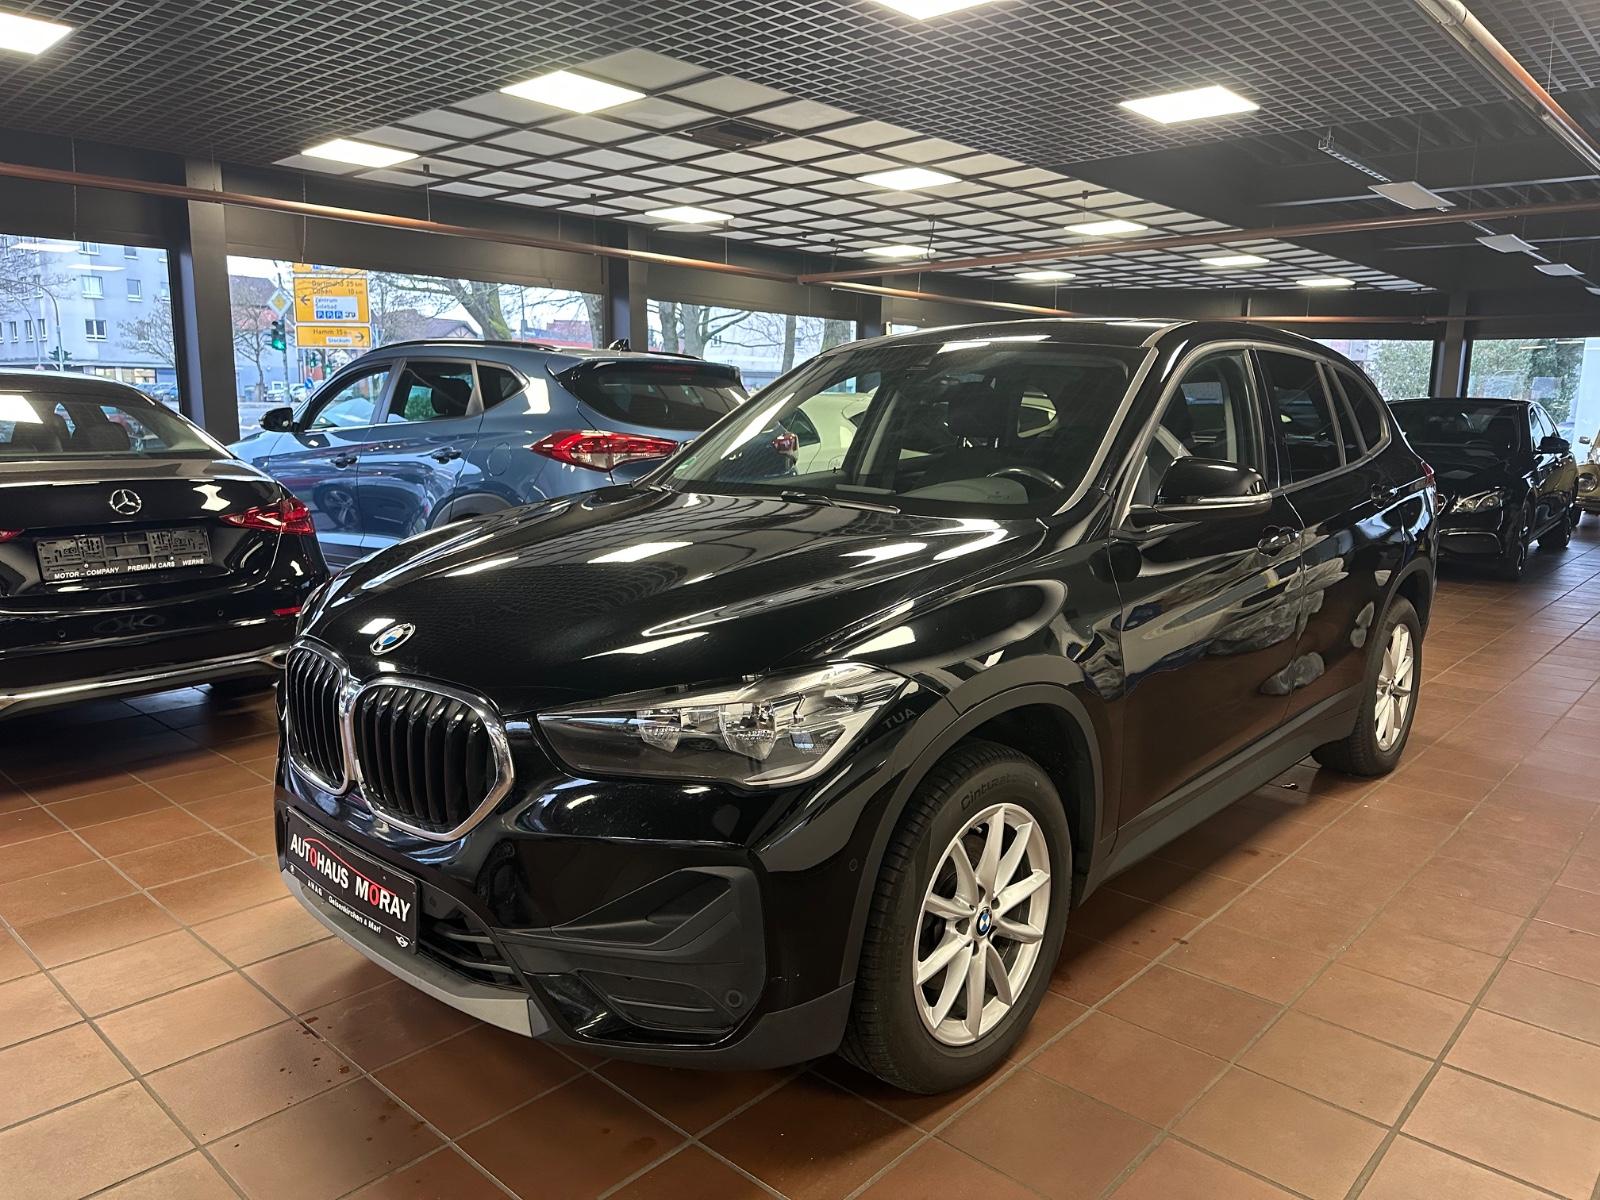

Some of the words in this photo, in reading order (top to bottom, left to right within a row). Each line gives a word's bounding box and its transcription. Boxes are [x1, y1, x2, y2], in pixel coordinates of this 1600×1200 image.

[54, 571, 79, 579] MOTOR
[86, 566, 120, 577] COMPANY
[127, 562, 157, 571] PREMIUM
[158, 561, 175, 569] CARS
[182, 558, 204, 566] WERNE
[290, 833, 349, 889] AUTOHAUS
[355, 875, 411, 922] MORAY
[368, 920, 381, 933] Marl
